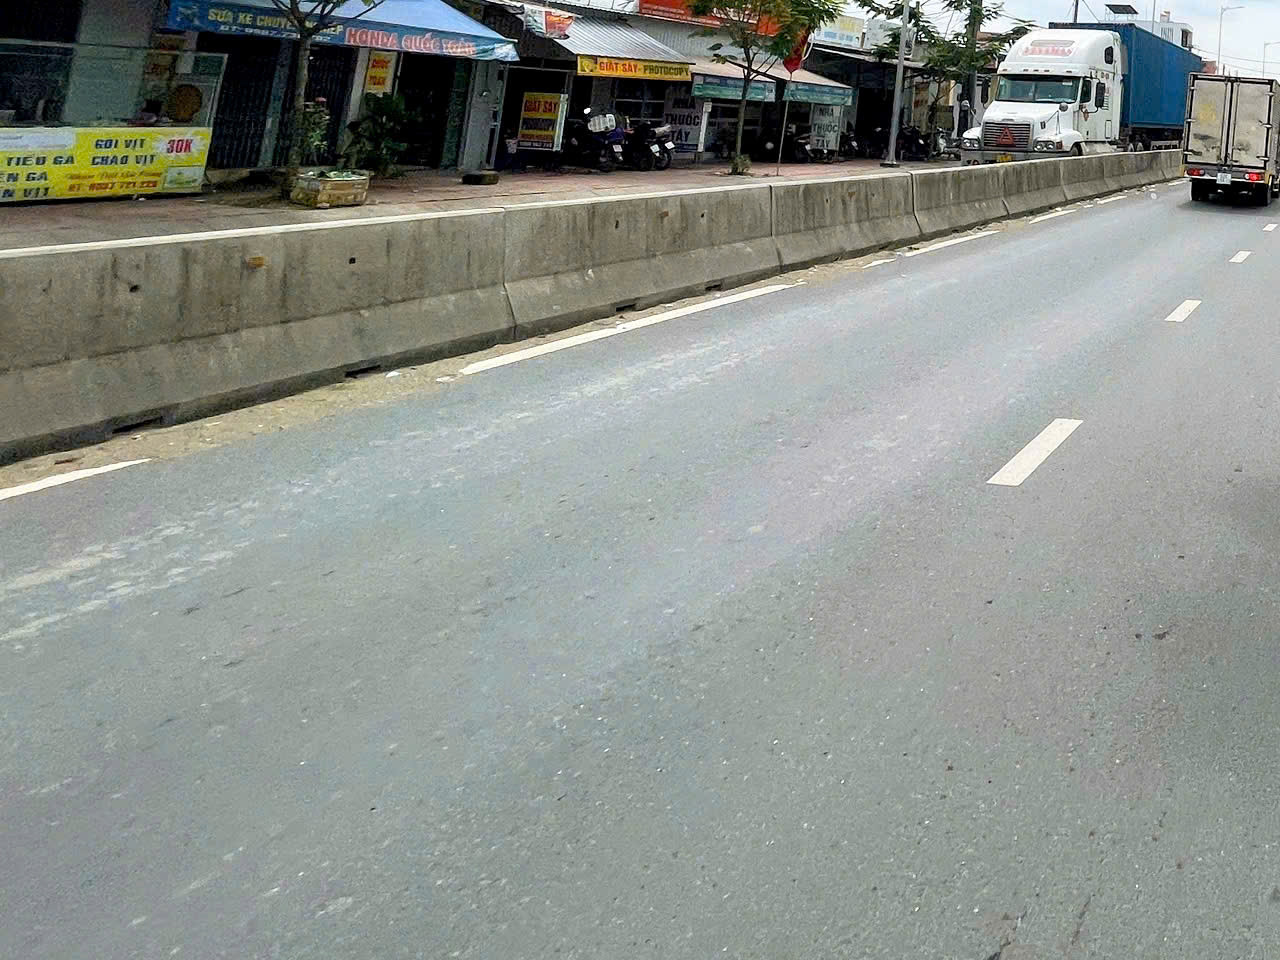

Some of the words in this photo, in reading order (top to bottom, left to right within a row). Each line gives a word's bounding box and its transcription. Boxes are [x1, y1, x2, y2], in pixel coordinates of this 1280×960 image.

[344, 27, 398, 49] HONDA
[643, 65, 690, 77] PHOTOCOPY
[166, 138, 193, 154] 30K
